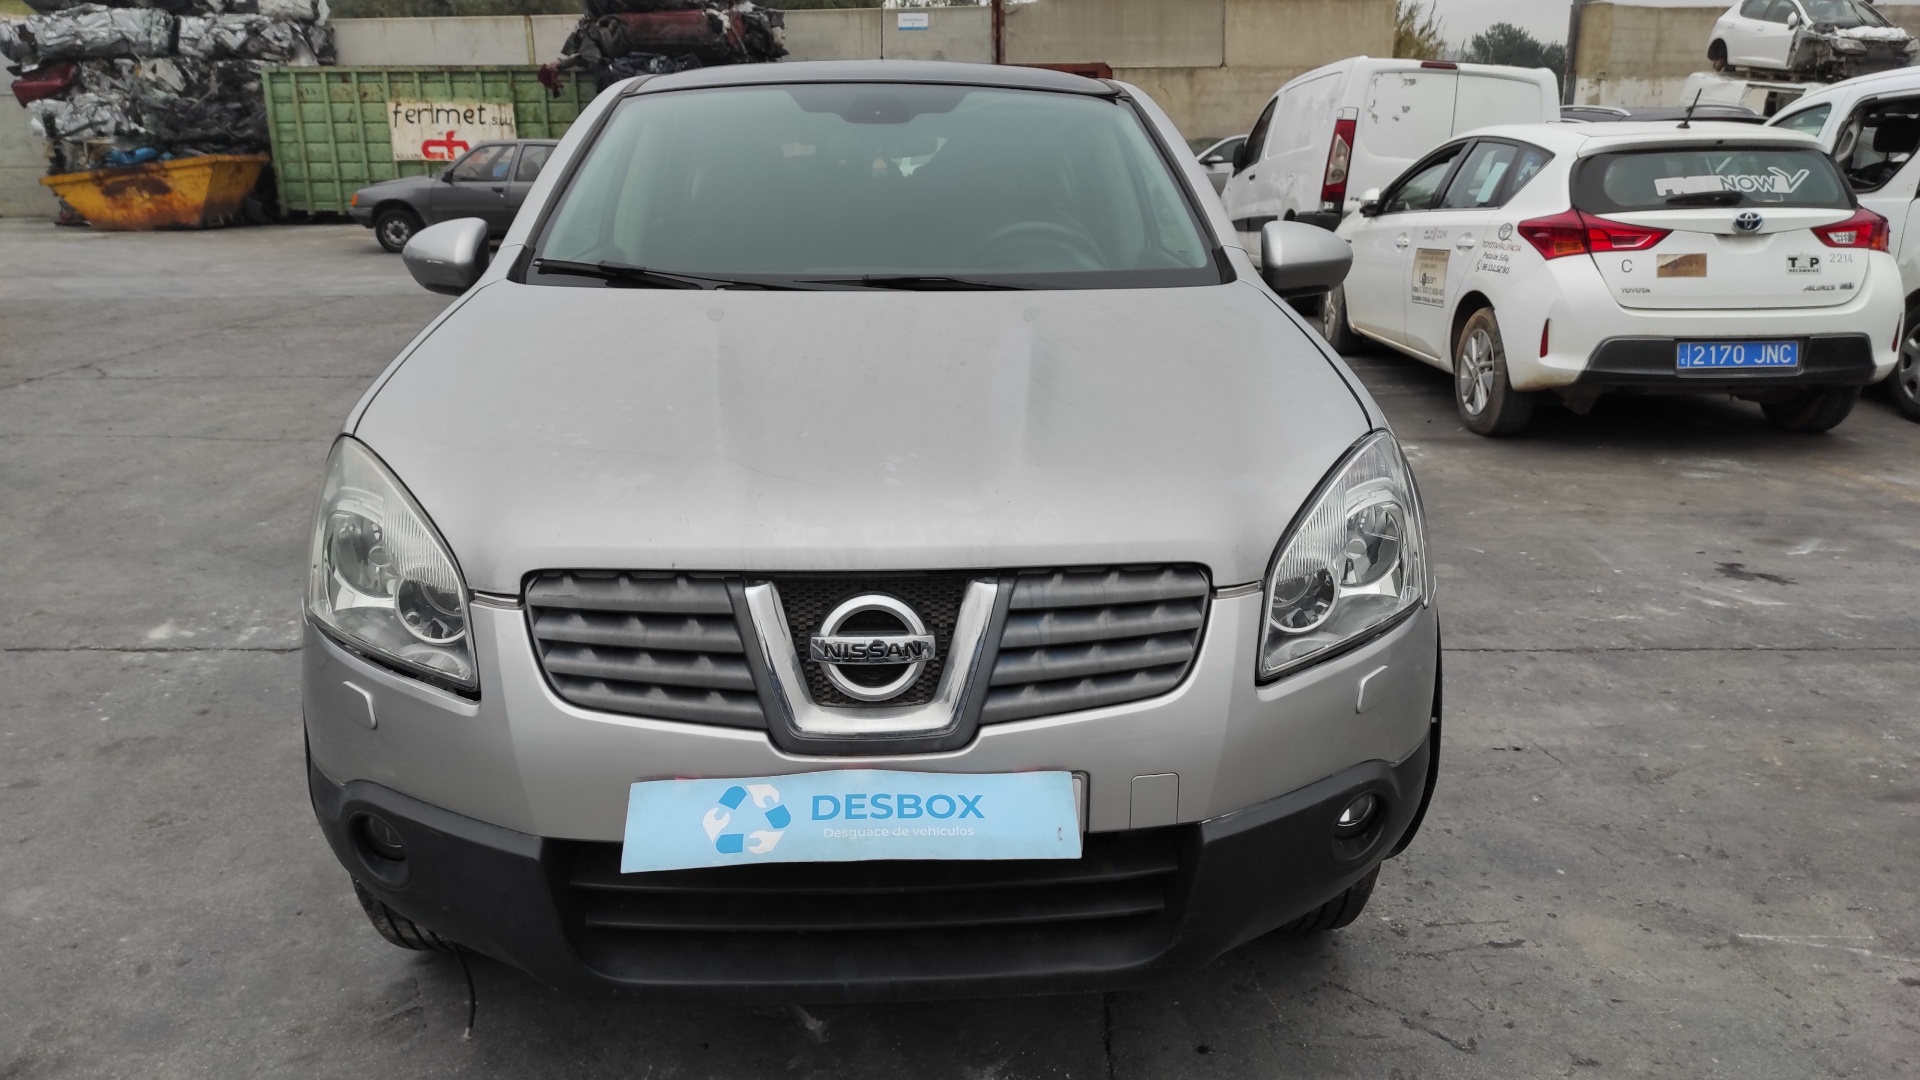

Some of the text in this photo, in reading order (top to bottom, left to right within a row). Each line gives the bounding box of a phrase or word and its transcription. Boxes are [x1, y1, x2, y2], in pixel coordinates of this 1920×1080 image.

[1720, 174, 1776, 193] NOW
[1621, 259, 1632, 273] C
[1829, 253, 1853, 263] 2214
[1693, 345, 1745, 365] 2170
[1754, 344, 1791, 364] JNC
[824, 642, 923, 660] NISSAN
[811, 793, 986, 821] DESBOX
[824, 828, 889, 839] Desguace
[892, 826, 909, 836] de
